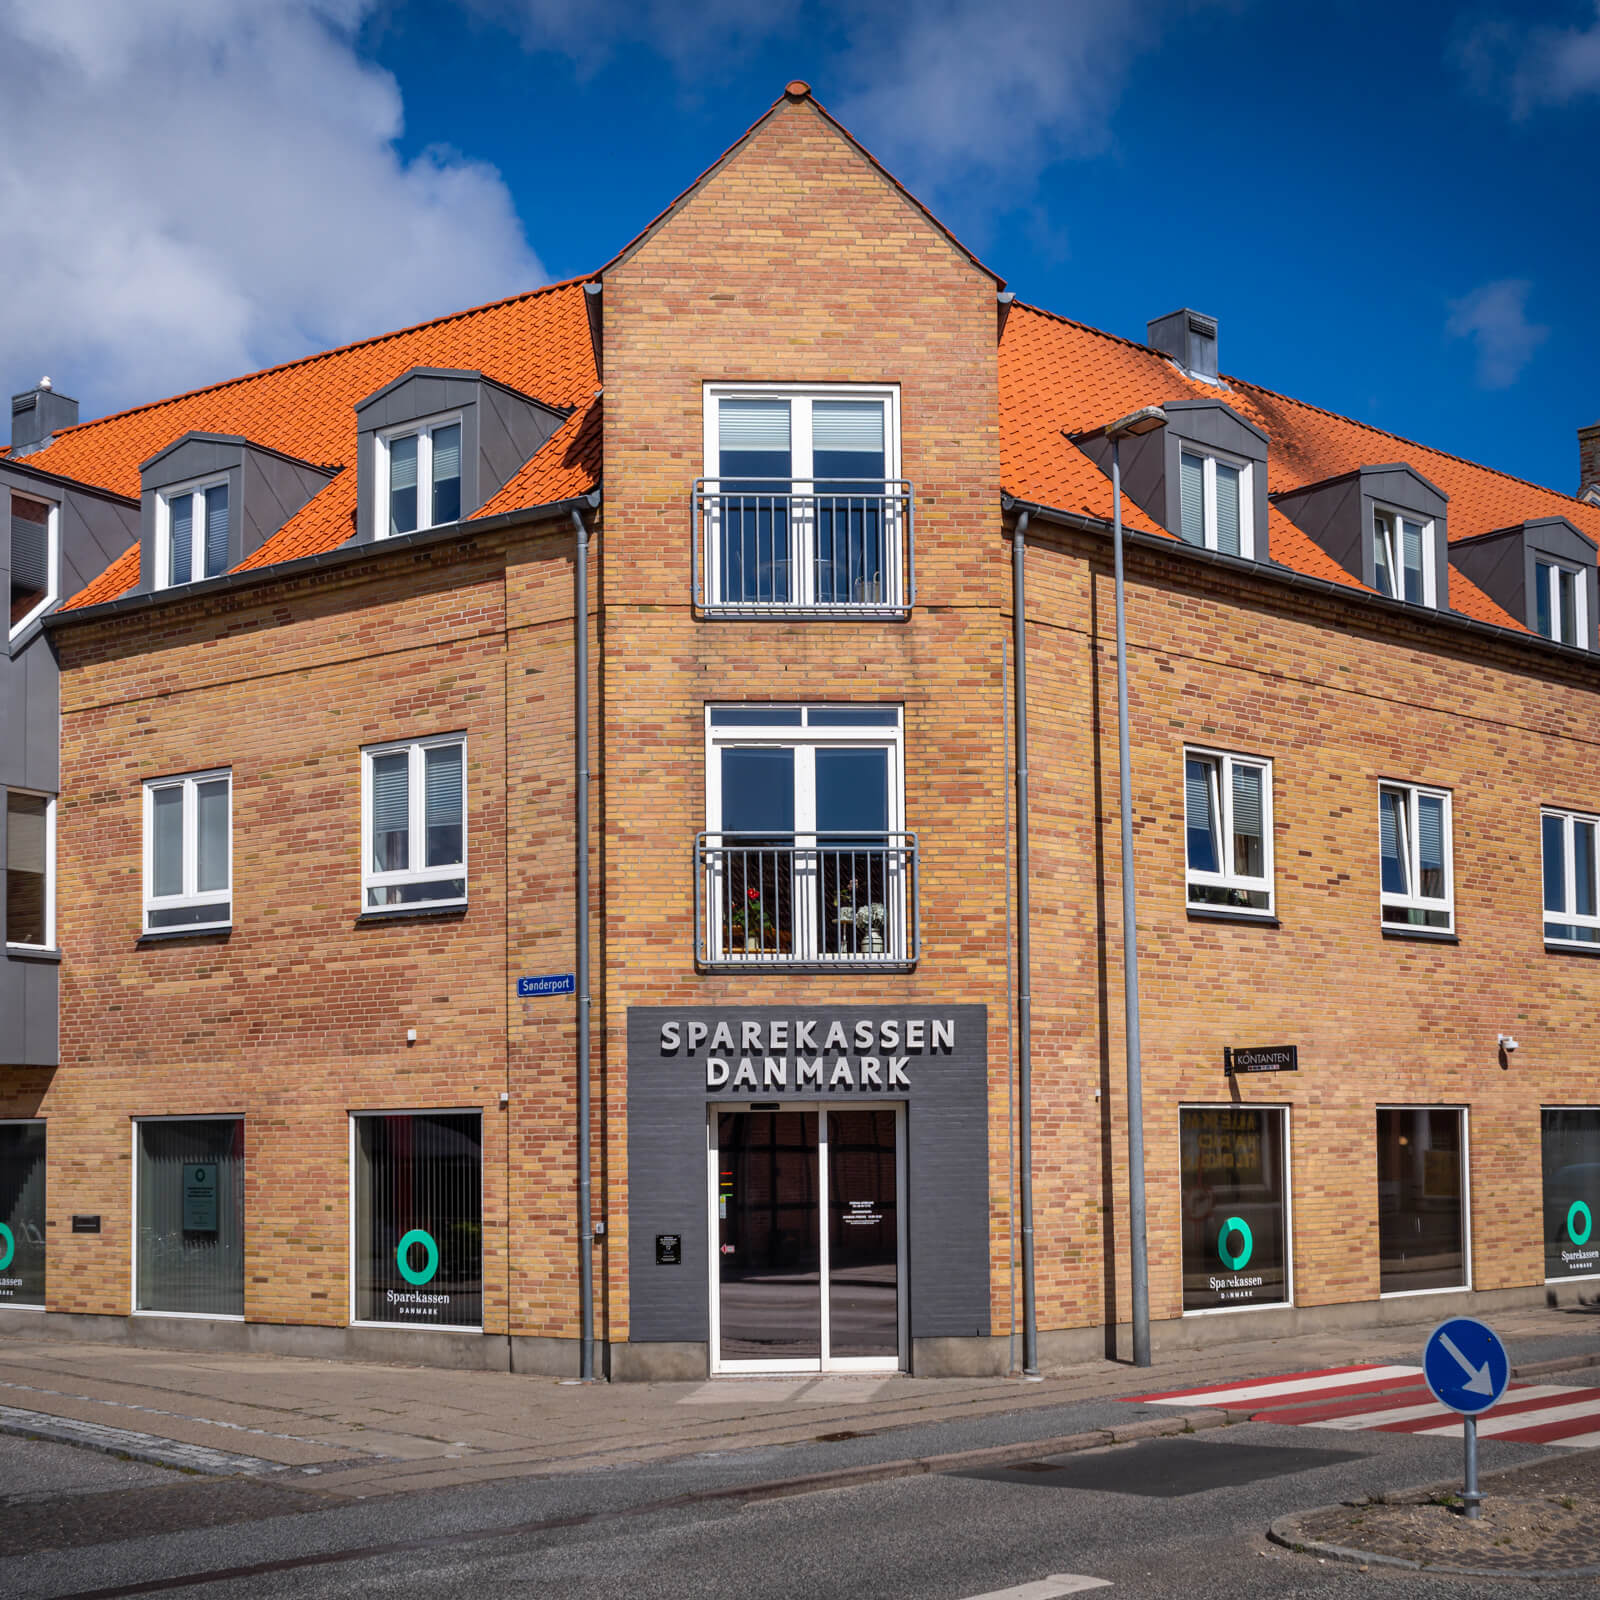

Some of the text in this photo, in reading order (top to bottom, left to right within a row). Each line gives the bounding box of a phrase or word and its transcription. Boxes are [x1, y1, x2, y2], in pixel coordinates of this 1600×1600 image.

[522, 976, 569, 992] Sønderport
[660, 1019, 955, 1051] SPAREKASSEN
[1237, 1051, 1290, 1065] KONTANTEN
[706, 1055, 911, 1086] DANMARK
[1561, 1249, 1599, 1263] Sparekassen
[1209, 1274, 1263, 1292] Sparekassen
[386, 1289, 450, 1304] Sparekassen
[399, 1306, 439, 1316] DANMARK
